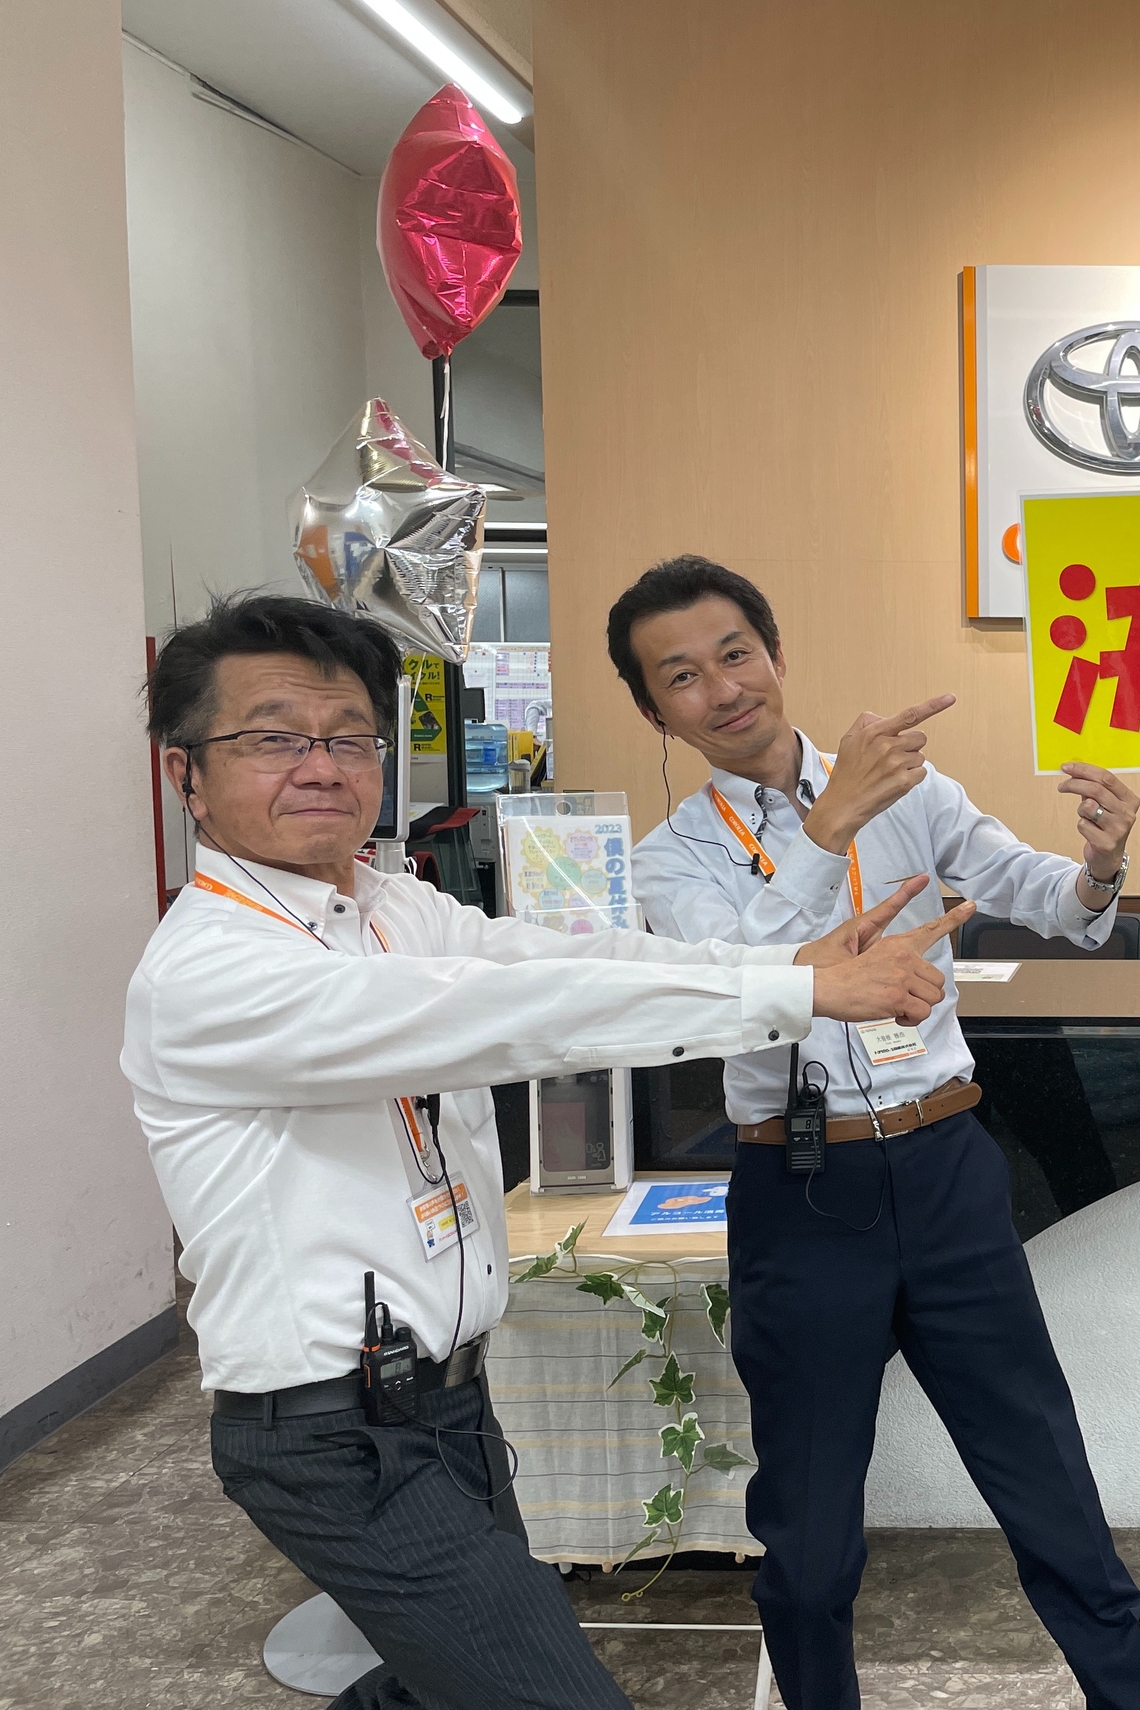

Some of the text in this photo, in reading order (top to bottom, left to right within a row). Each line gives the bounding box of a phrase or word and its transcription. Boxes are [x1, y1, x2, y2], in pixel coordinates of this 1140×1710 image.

[595, 823, 622, 834] 2023
[728, 816, 746, 837] COROLLA
[748, 843, 768, 867] CORLLA
[806, 1120, 811, 1129] 8
